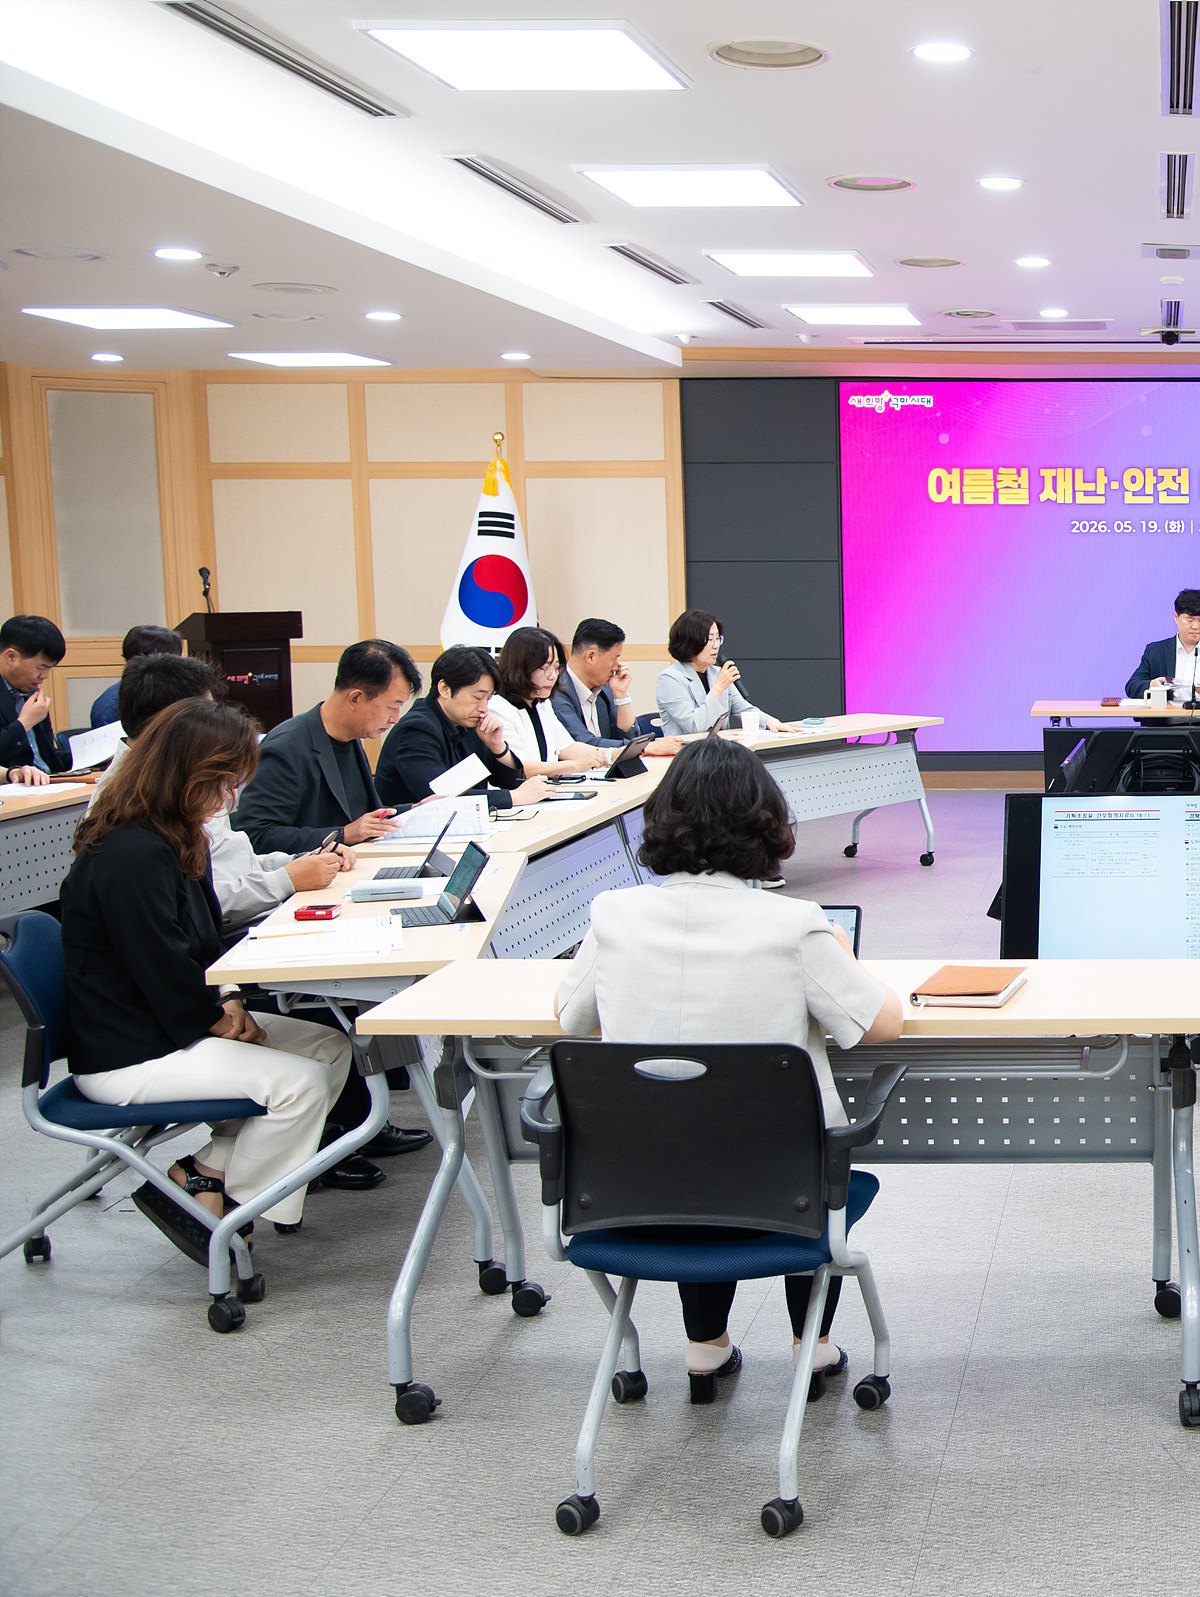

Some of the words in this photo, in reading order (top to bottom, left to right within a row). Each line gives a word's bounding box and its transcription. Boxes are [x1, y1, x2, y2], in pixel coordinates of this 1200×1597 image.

[927, 466, 1030, 505] 여름철
[1039, 466, 1190, 505] 재난·안전
[1070, 520, 1111, 534] 2026.
[1113, 520, 1136, 534] 05.
[1140, 520, 1161, 534] 19.
[1164, 519, 1185, 534] (화)
